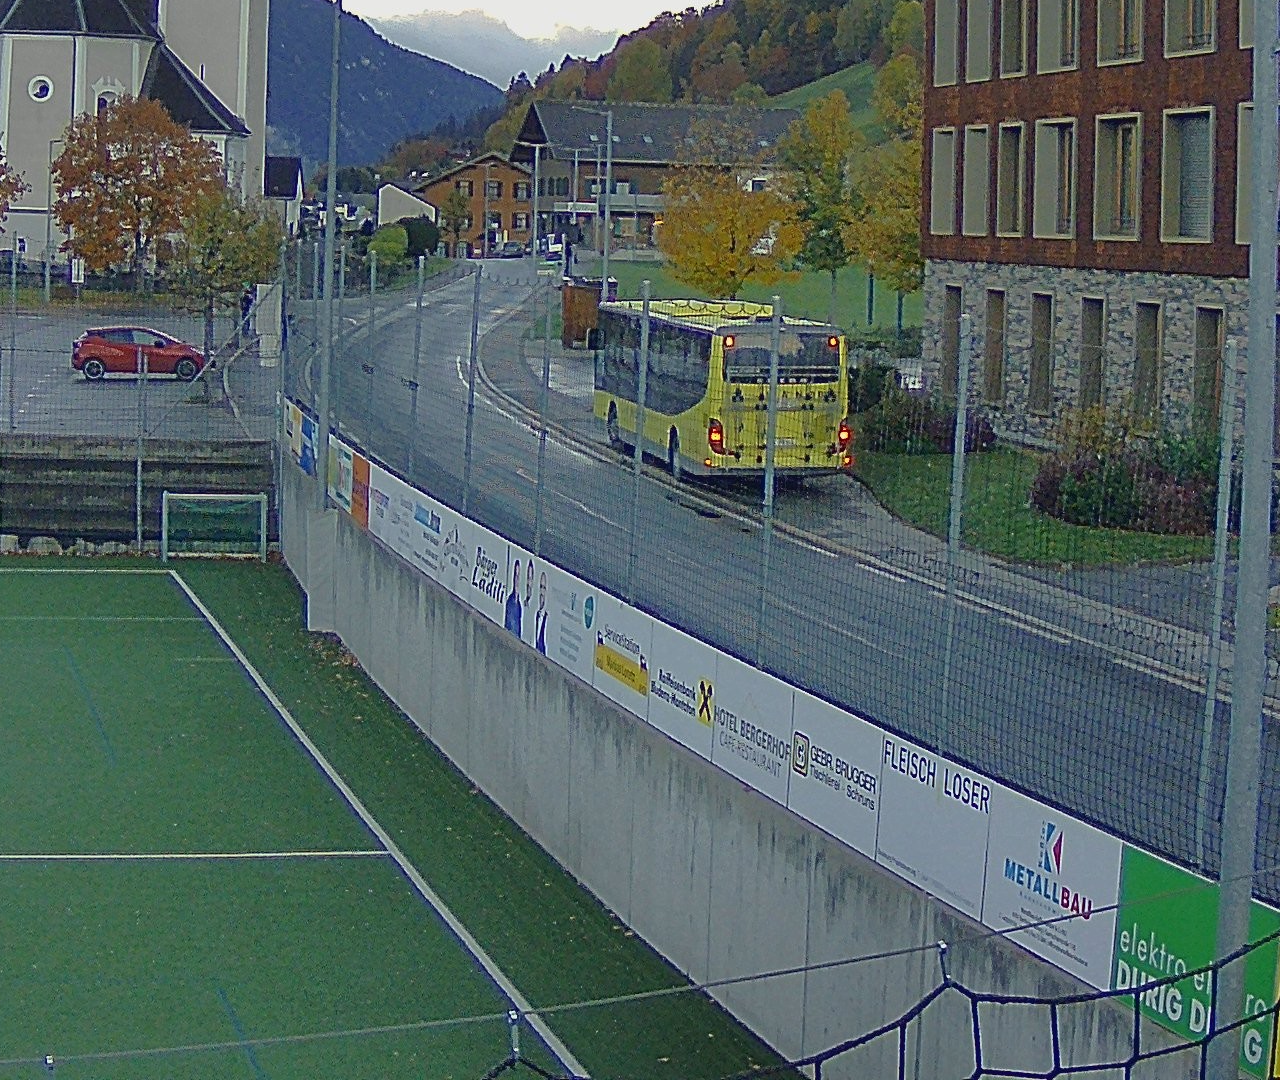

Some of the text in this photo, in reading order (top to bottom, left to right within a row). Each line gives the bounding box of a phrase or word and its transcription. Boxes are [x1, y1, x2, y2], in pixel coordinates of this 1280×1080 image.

[713, 705, 792, 762] HOTEL BERGERHOF
[835, 757, 877, 795] BRUGGER
[846, 784, 875, 811] Schruns
[884, 739, 990, 814] FLEISCH LOSER
[1004, 857, 1093, 921] METALLBAU
[1120, 922, 1187, 978] elektro
[1193, 960, 1268, 1021] elro
